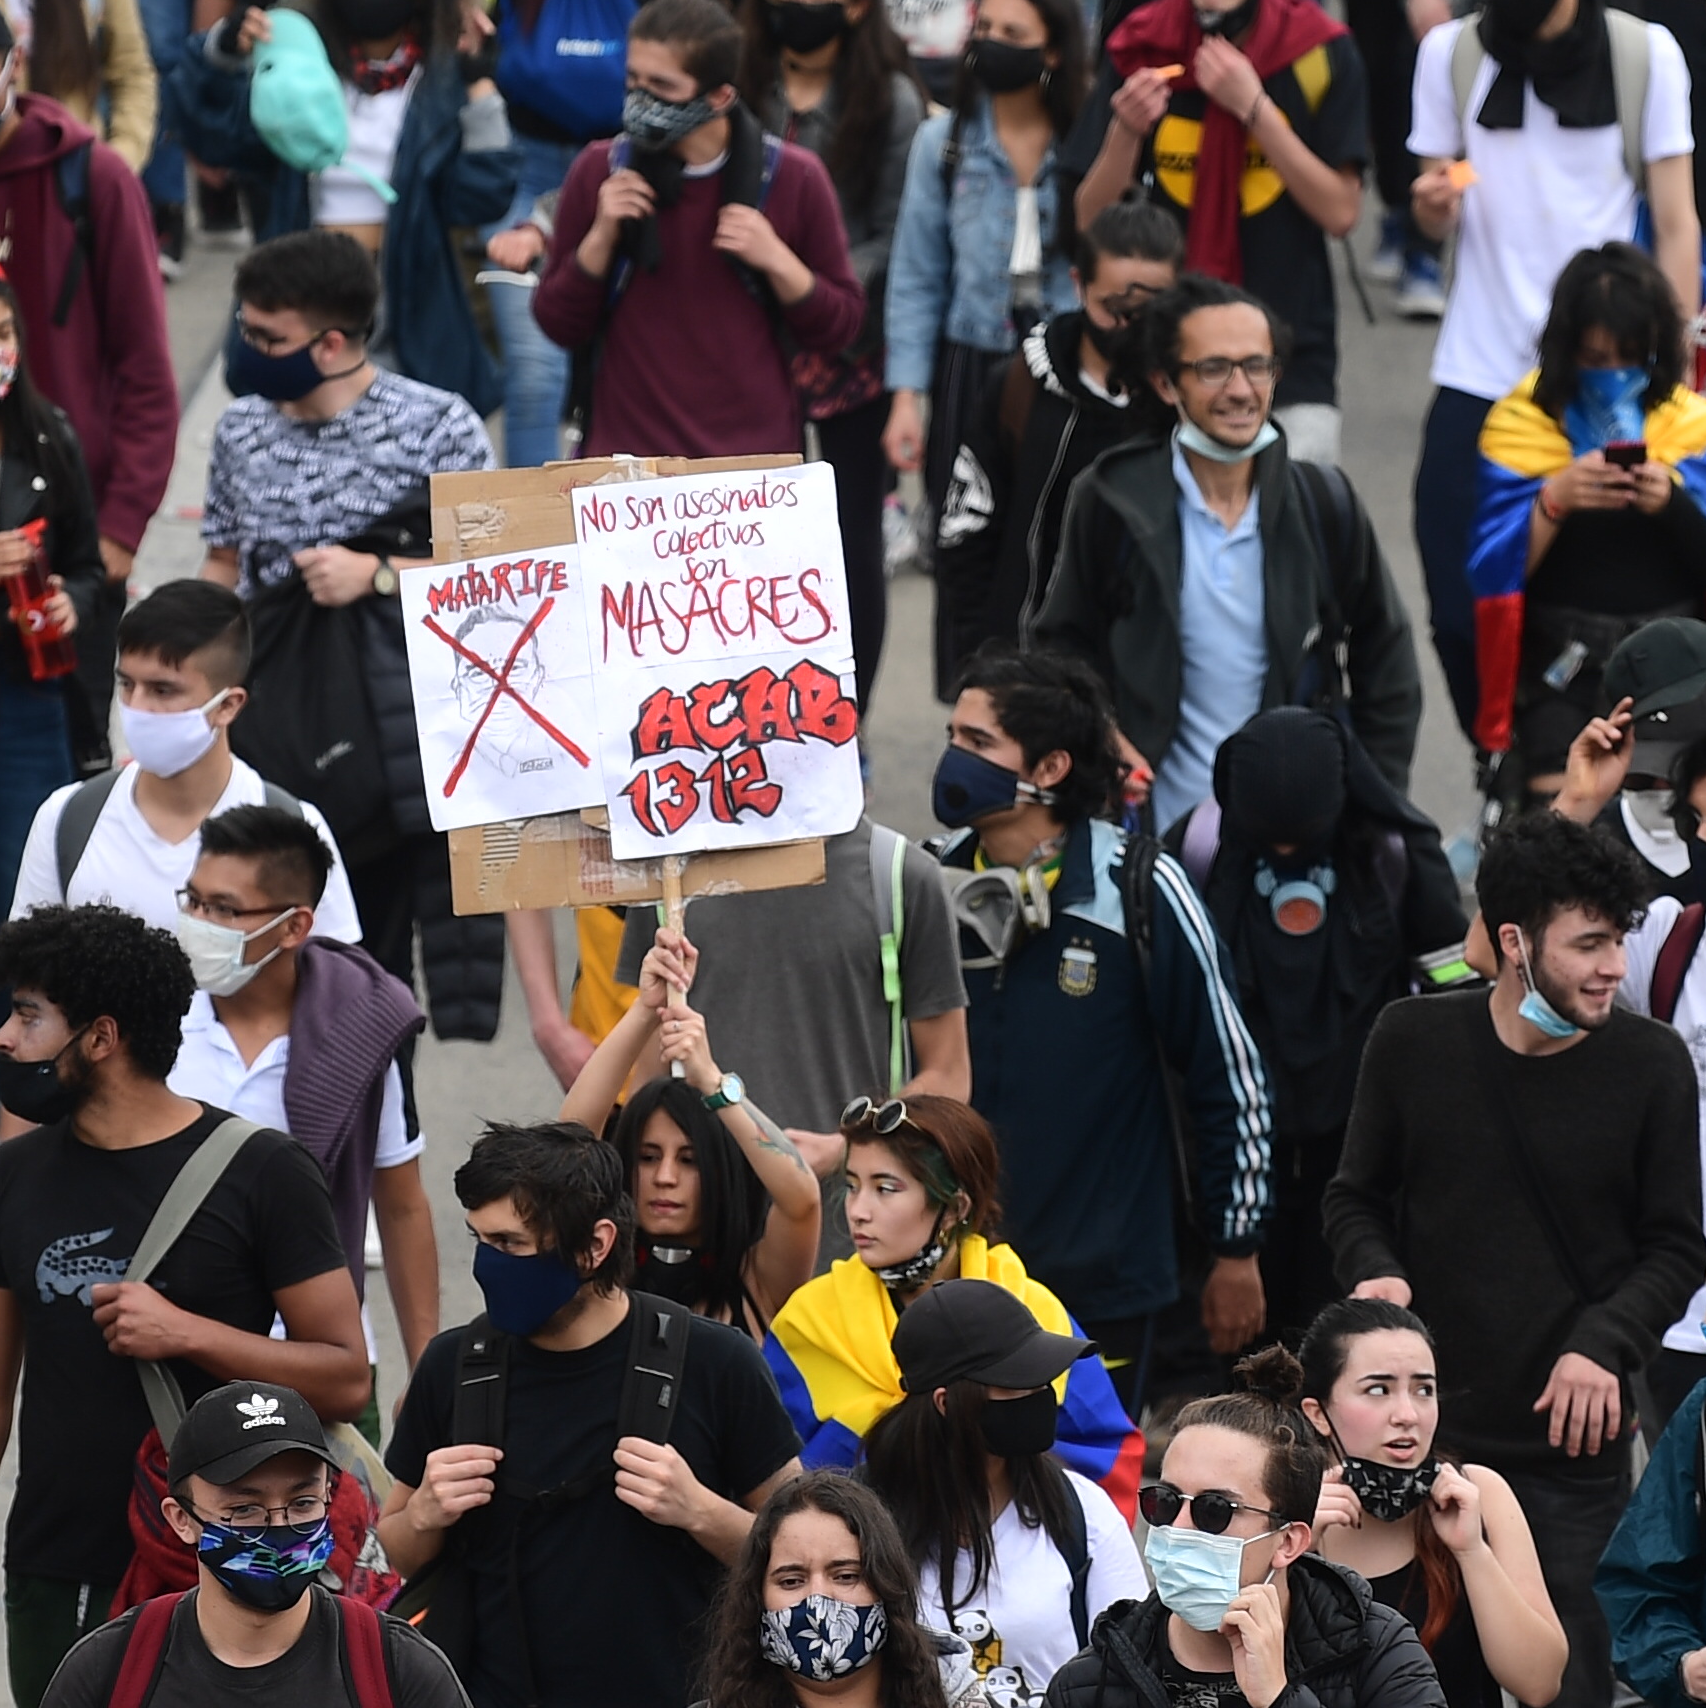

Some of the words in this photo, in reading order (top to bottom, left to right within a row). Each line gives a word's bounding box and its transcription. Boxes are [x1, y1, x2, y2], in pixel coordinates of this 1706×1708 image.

[427, 558, 569, 615] MATARIFE
[630, 658, 859, 767] ACAB
[617, 746, 783, 839] 1312
[242, 1414, 287, 1430] adidas
